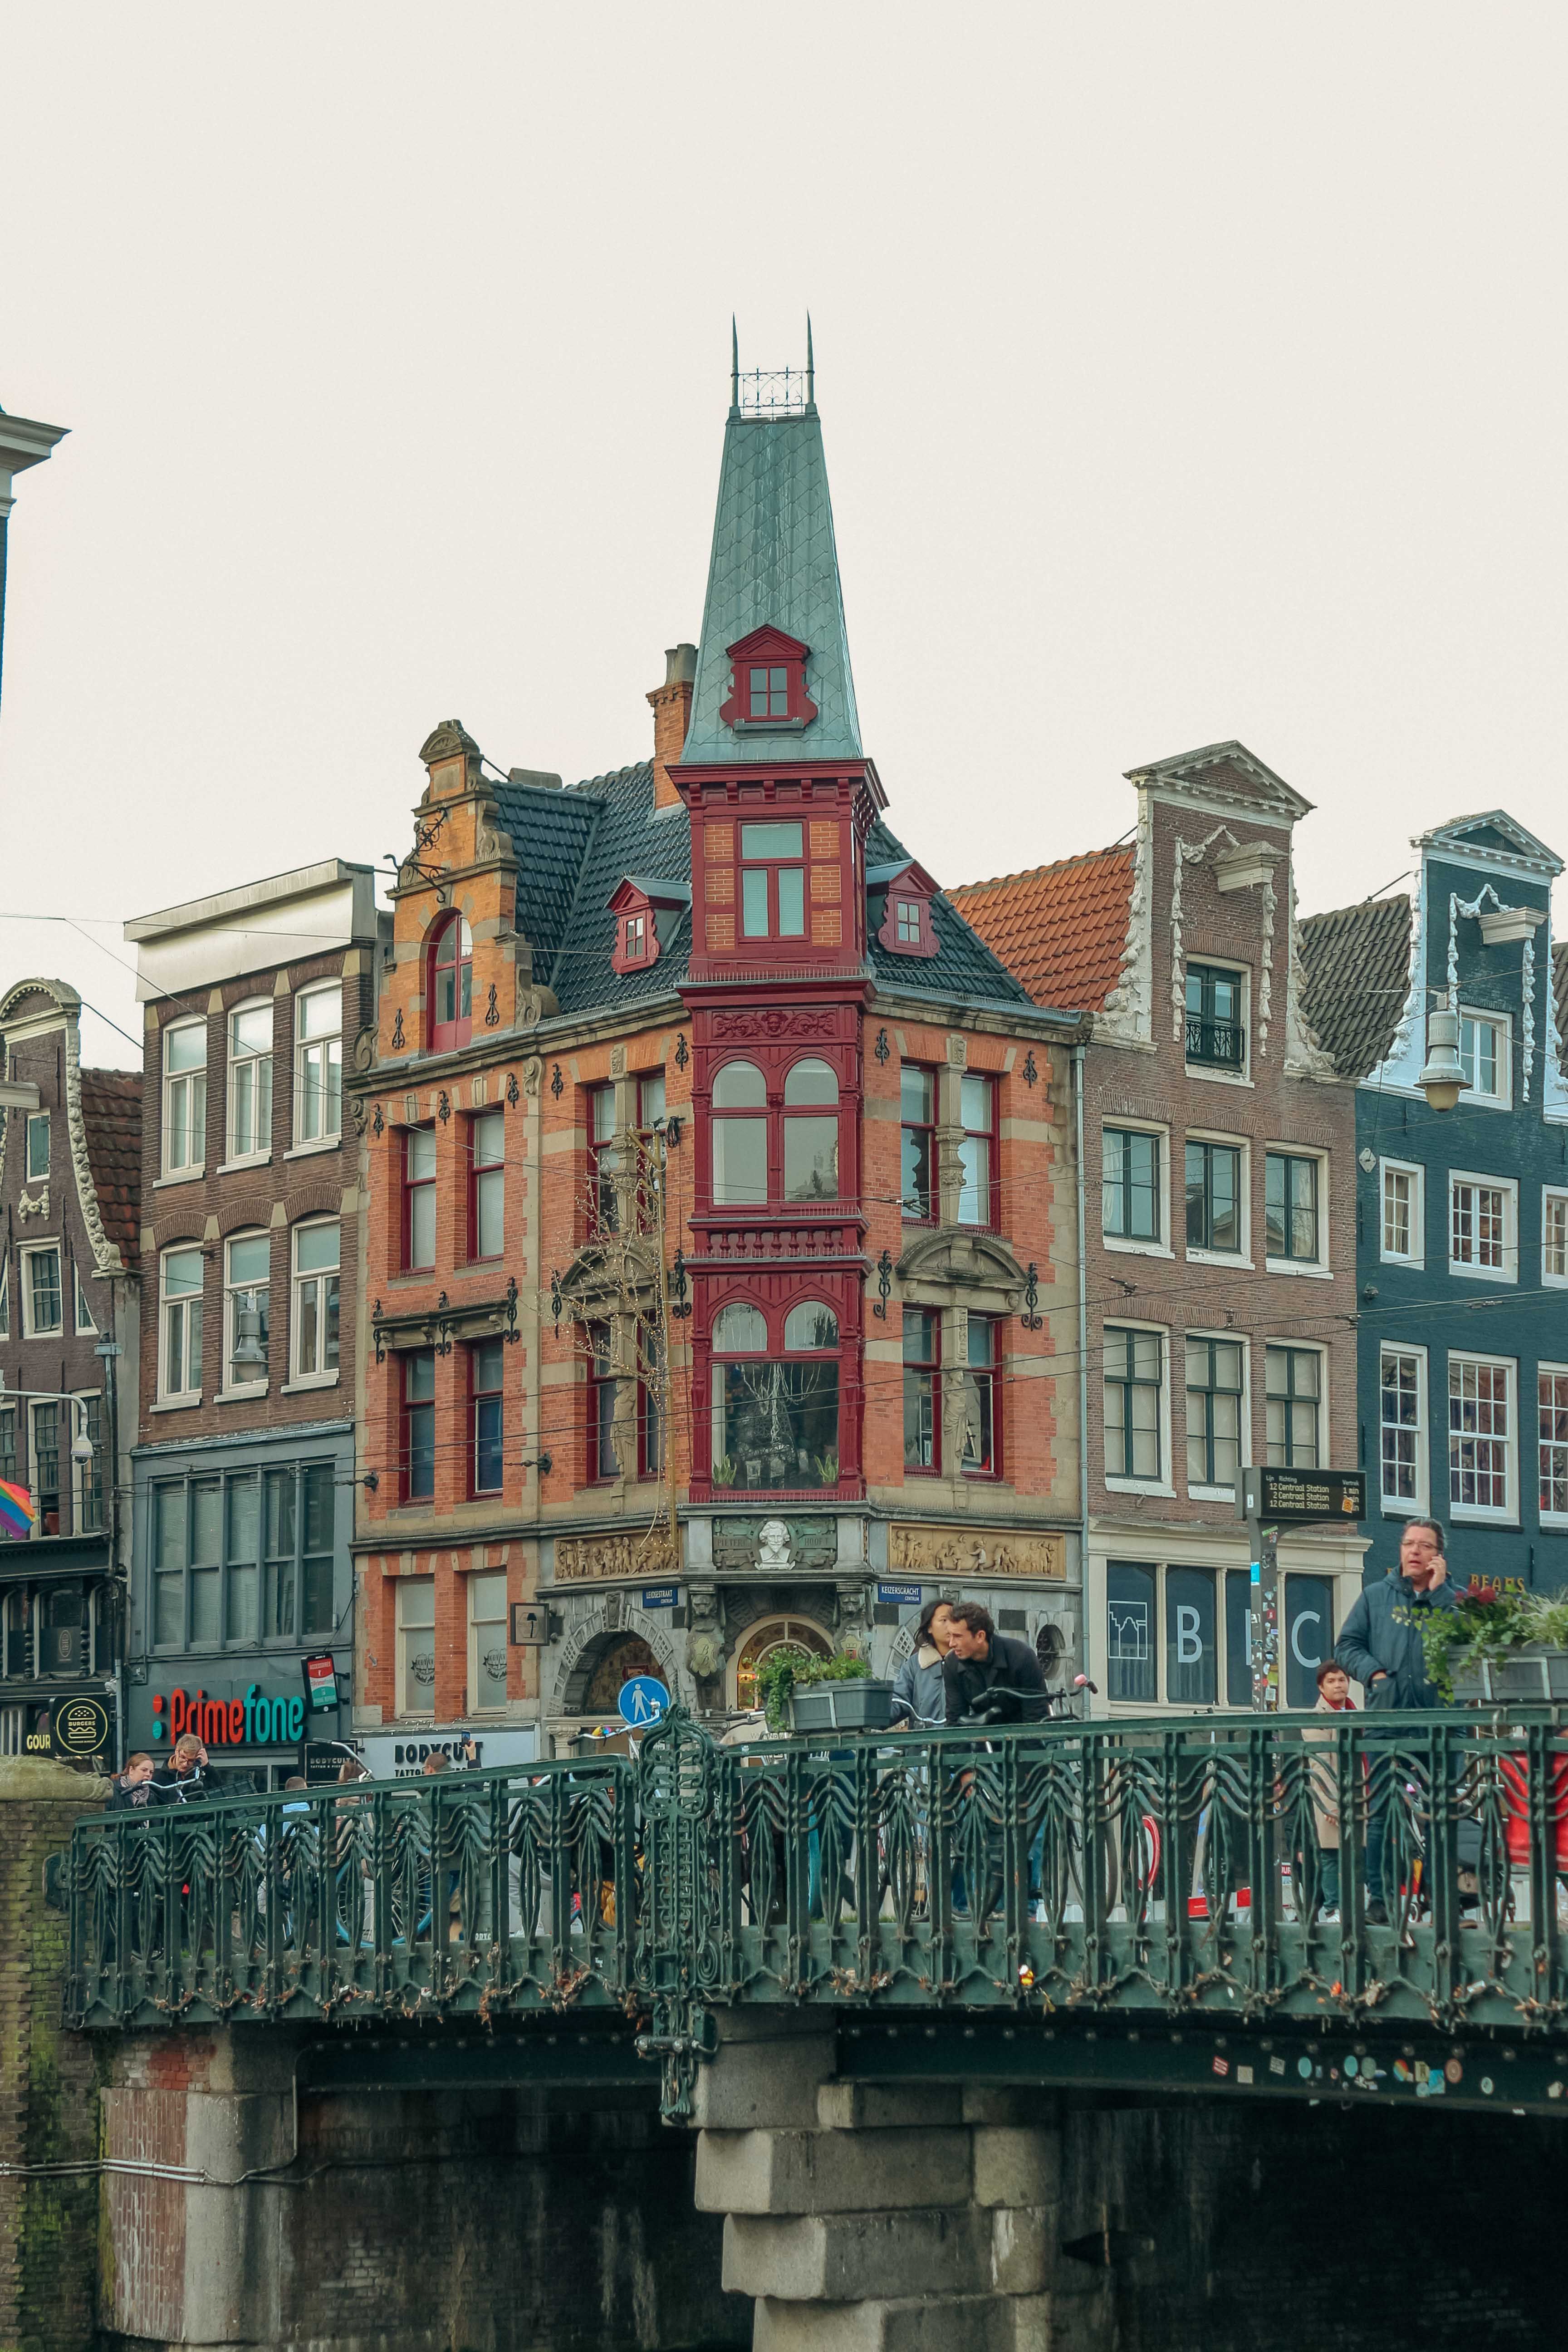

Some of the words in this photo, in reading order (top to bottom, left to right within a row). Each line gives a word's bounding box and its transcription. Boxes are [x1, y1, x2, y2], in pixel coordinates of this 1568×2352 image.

[1279, 1483, 1304, 1492] Centraal
[1306, 1484, 1329, 1493] Station
[1279, 1492, 1304, 1500] Centraal
[1306, 1493, 1329, 1501] Station
[1279, 1500, 1304, 1509] Centraal
[1306, 1501, 1329, 1510] Station
[646, 1589, 672, 1599] LEIDSESTRAAT
[881, 1586, 919, 1595] KEIZERSGRACHT
[171, 1684, 304, 1745] Primefone
